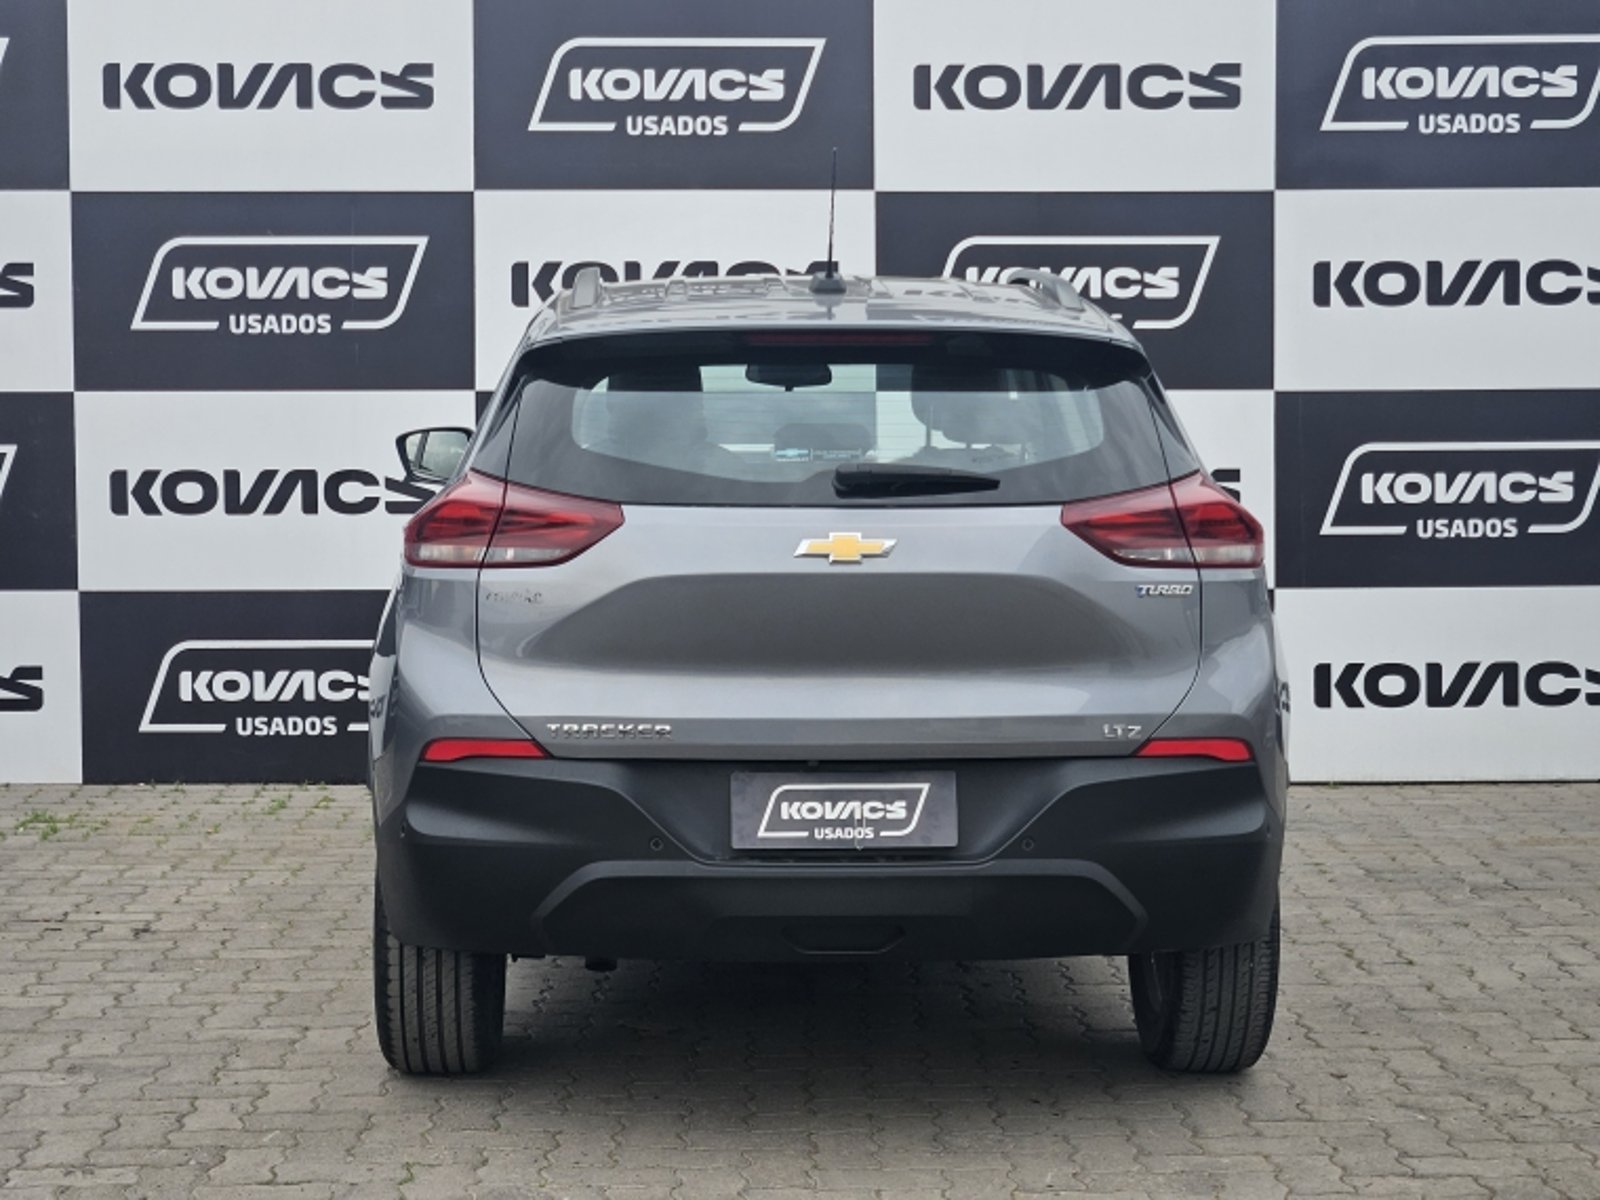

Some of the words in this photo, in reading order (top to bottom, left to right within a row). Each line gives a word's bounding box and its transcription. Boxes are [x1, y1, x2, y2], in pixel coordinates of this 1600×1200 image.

[102, 62, 435, 110] KOVACS
[568, 68, 785, 101] KOVACS
[913, 62, 1242, 111] KOVACS
[1361, 65, 1578, 99] KOVACS
[626, 115, 729, 136] USADOS
[1418, 113, 1521, 134] USADOS
[171, 266, 388, 300] KOVACS
[1313, 259, 1600, 307] KOVAC
[229, 313, 332, 334] USADOS
[1360, 471, 1575, 505] KOVACS
[1416, 517, 1518, 539] USADOS
[1137, 584, 1193, 596] TURBO
[179, 669, 369, 702] KOVAC
[1313, 661, 1600, 709] KOVAC
[236, 716, 338, 736] USADOS
[546, 723, 672, 739] TRACKER
[1103, 723, 1142, 739] LTZ
[780, 800, 908, 821] KOVACS
[814, 827, 875, 840] USADOS
